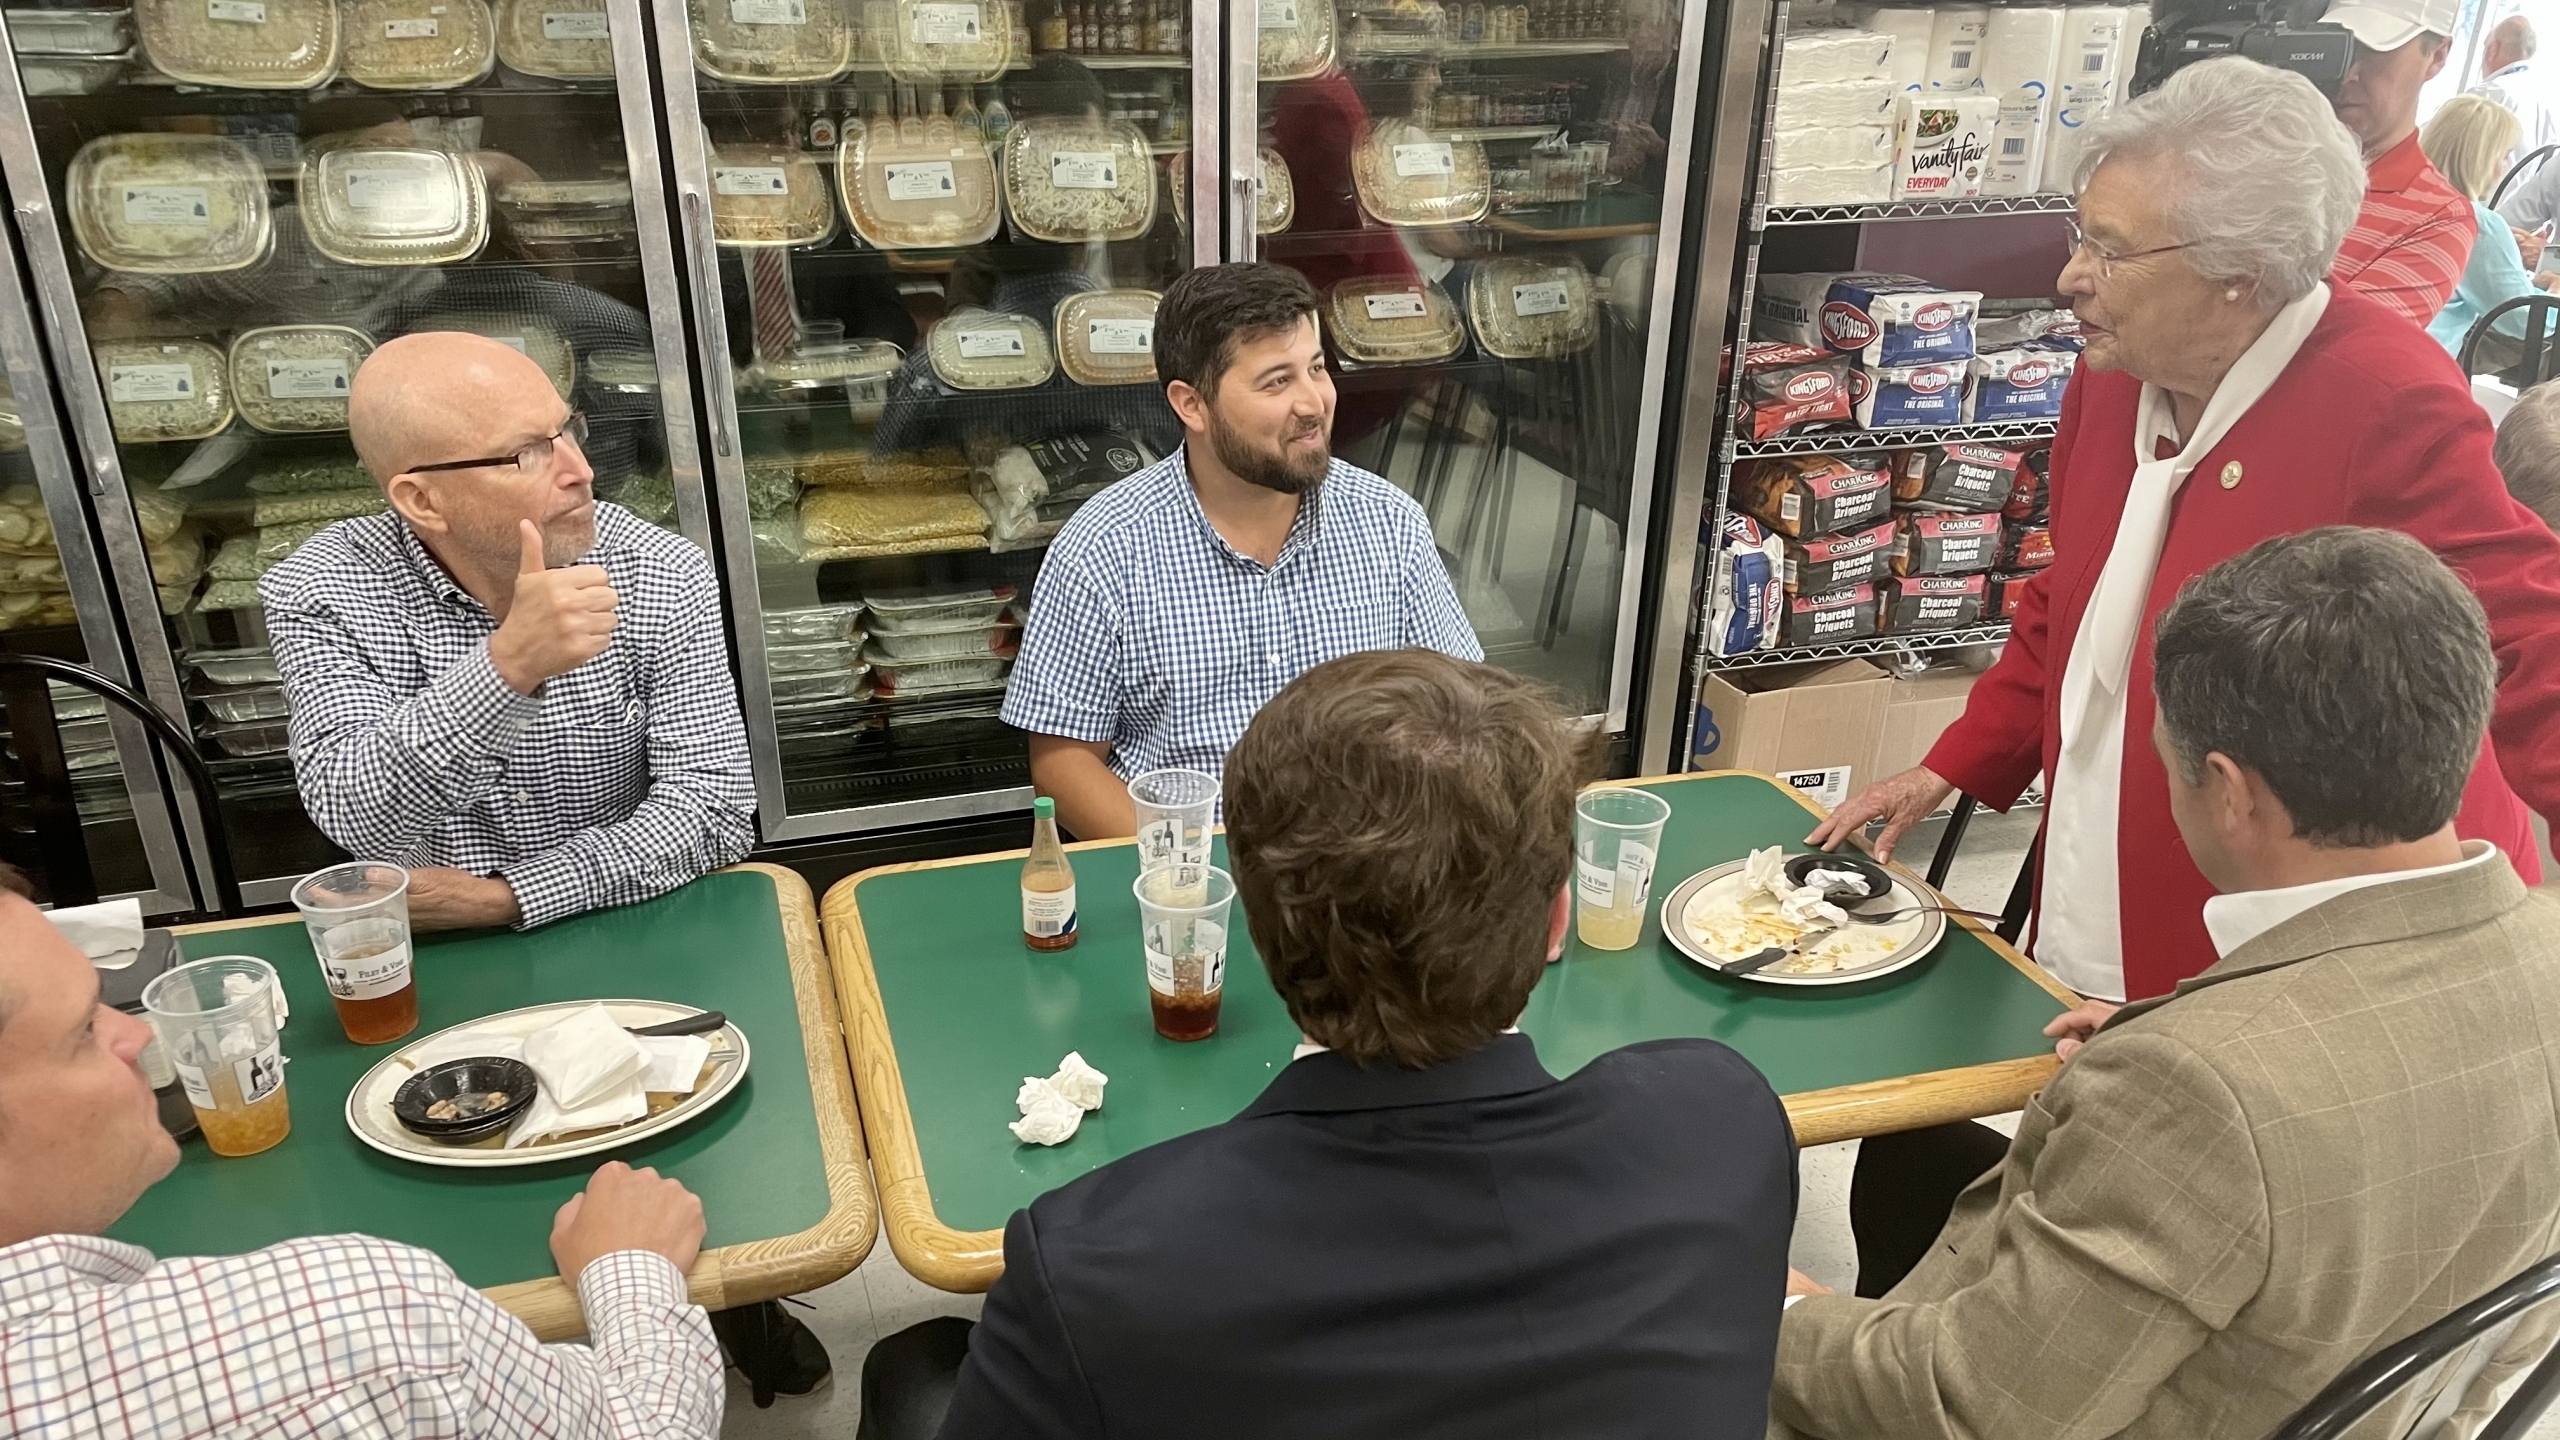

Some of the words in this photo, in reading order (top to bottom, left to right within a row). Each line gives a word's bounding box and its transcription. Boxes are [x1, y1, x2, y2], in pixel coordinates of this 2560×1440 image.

[1906, 177, 1951, 189] EVERYDAY
[1769, 301, 1810, 324] ORIGINAL
[1917, 307, 1952, 327] KINGSFORD
[1824, 310, 1871, 340] KINGSFORD
[1913, 339, 1926, 349] THE
[1926, 335, 1953, 348] ORIGINAL
[1913, 372, 1948, 390] KINGSFORD
[2012, 365, 2048, 384] KINGSFORD
[1789, 376, 1831, 396] KINGSFORD
[1904, 400, 1917, 409] THE
[1917, 399, 1945, 409] ORIGINAL
[2005, 395, 2018, 404] THE
[2018, 391, 2047, 403] ORIGINAL
[1811, 401, 1834, 413] LIGHT
[1958, 463, 1997, 480] Charcoal
[1954, 475, 1991, 492] Briquets
[1834, 490, 1878, 509] Charcoal
[1833, 502, 1873, 520] Briquets
[1942, 537, 1981, 550] Charcoal
[1832, 551, 1874, 572] Charcoal
[1942, 549, 1979, 562] Briquets
[1831, 564, 1872, 581] Briquets
[1748, 582, 1757, 598] THE
[1920, 596, 1963, 608] Charcoal
[1746, 598, 1758, 630] ORIGINAL
[1814, 606, 1856, 623] Charcoal
[1918, 607, 1958, 619] Briquets
[1814, 618, 1855, 634] Briquets
[1793, 775, 1820, 787] 14750
[358, 969, 380, 979] FILET
[381, 965, 388, 974] &
